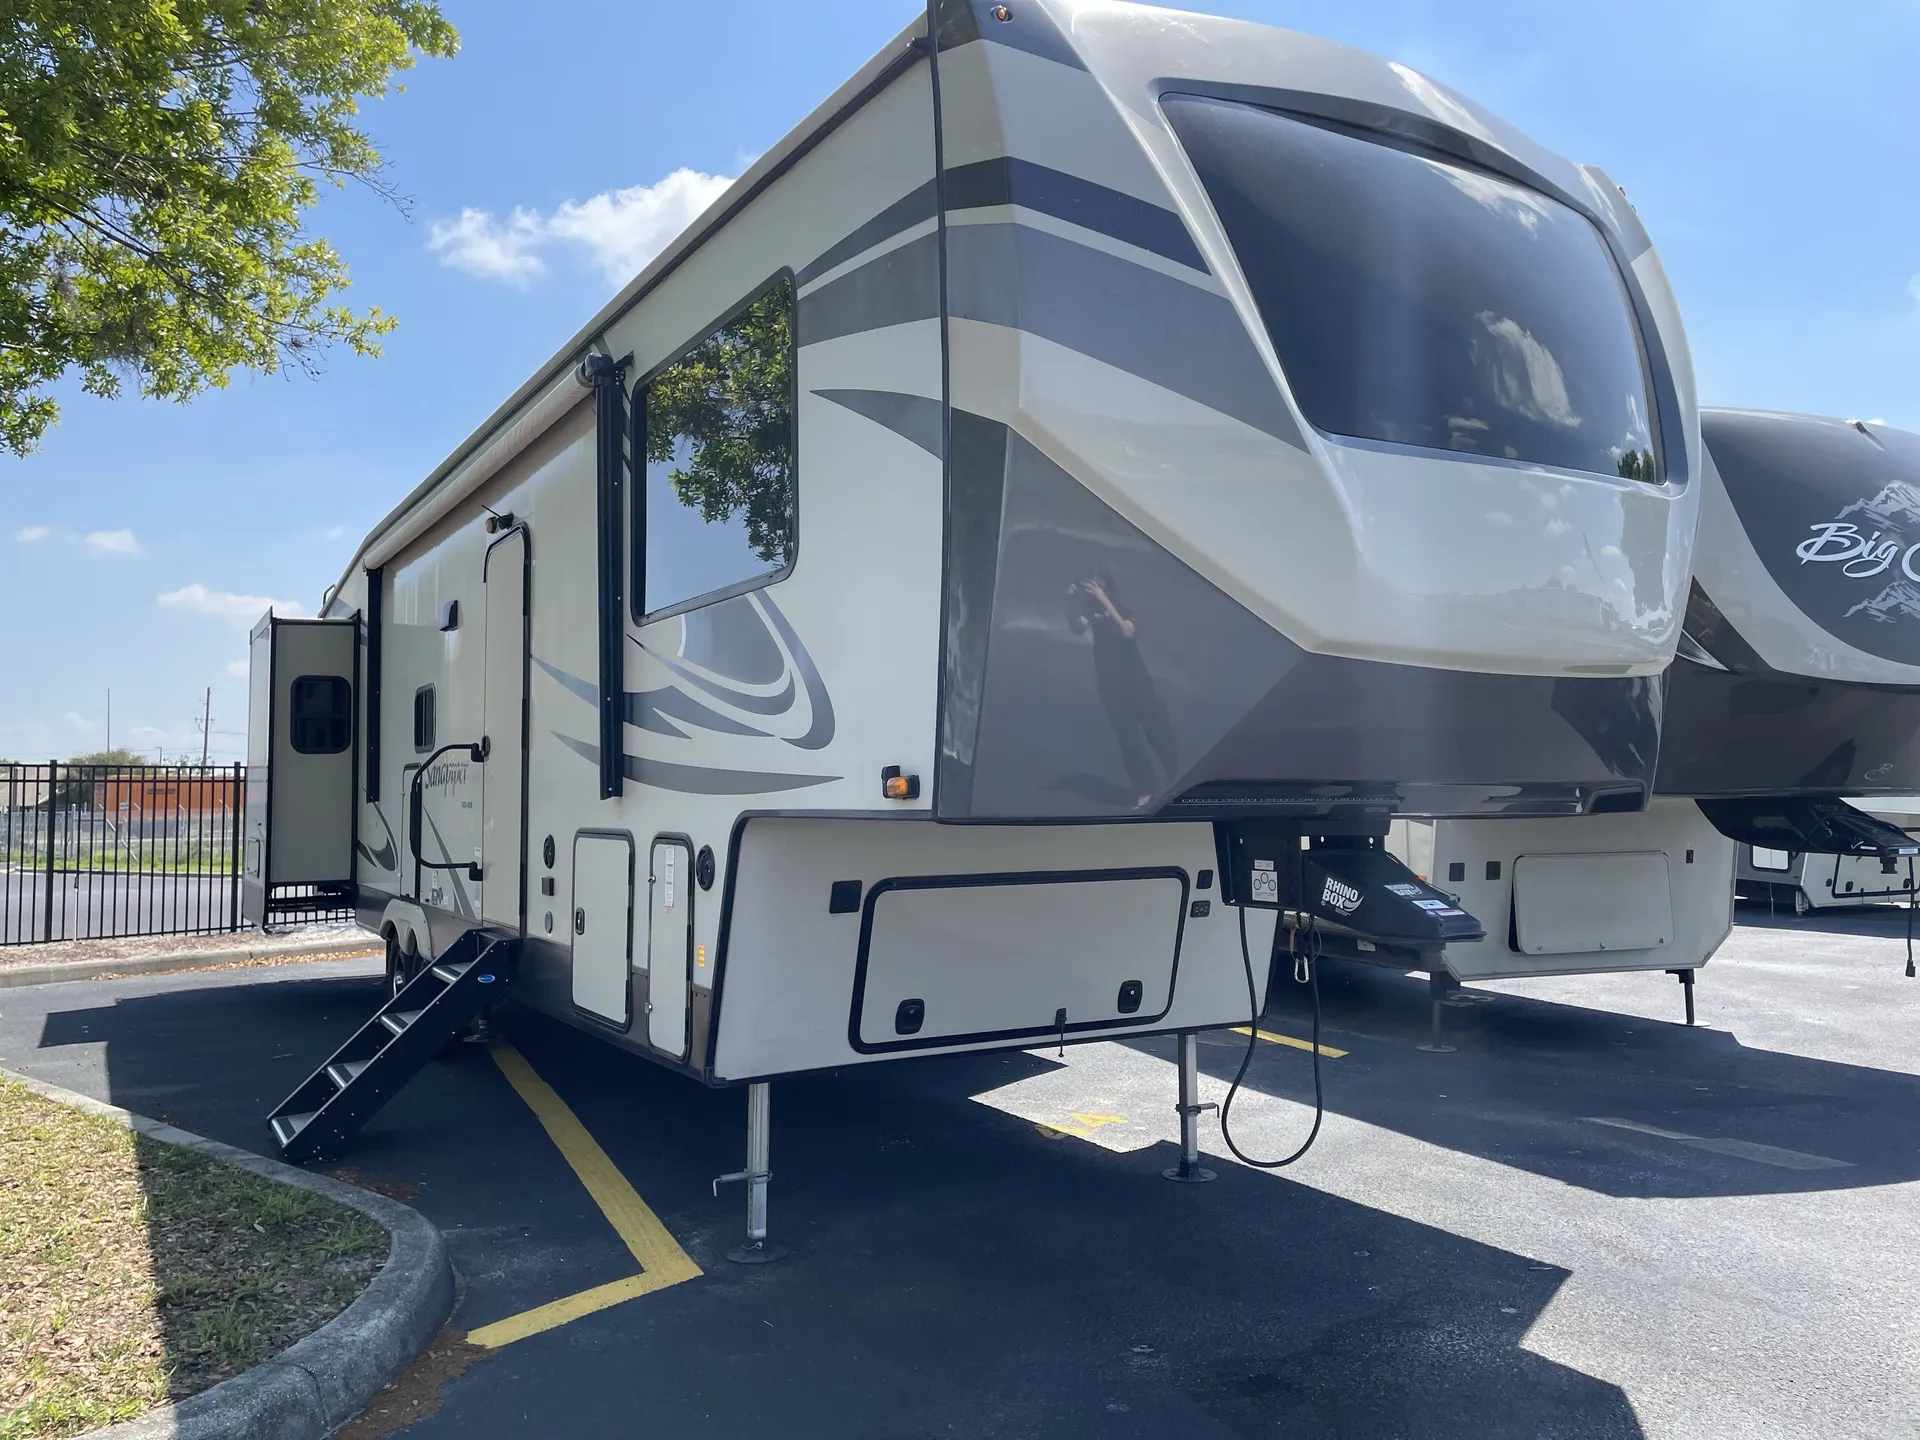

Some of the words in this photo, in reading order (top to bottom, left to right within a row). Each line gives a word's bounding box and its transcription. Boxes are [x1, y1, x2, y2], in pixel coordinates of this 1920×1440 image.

[1796, 522, 1899, 578] Big
[1322, 888, 1346, 909] BOX
[1325, 877, 1359, 901] RHINO
